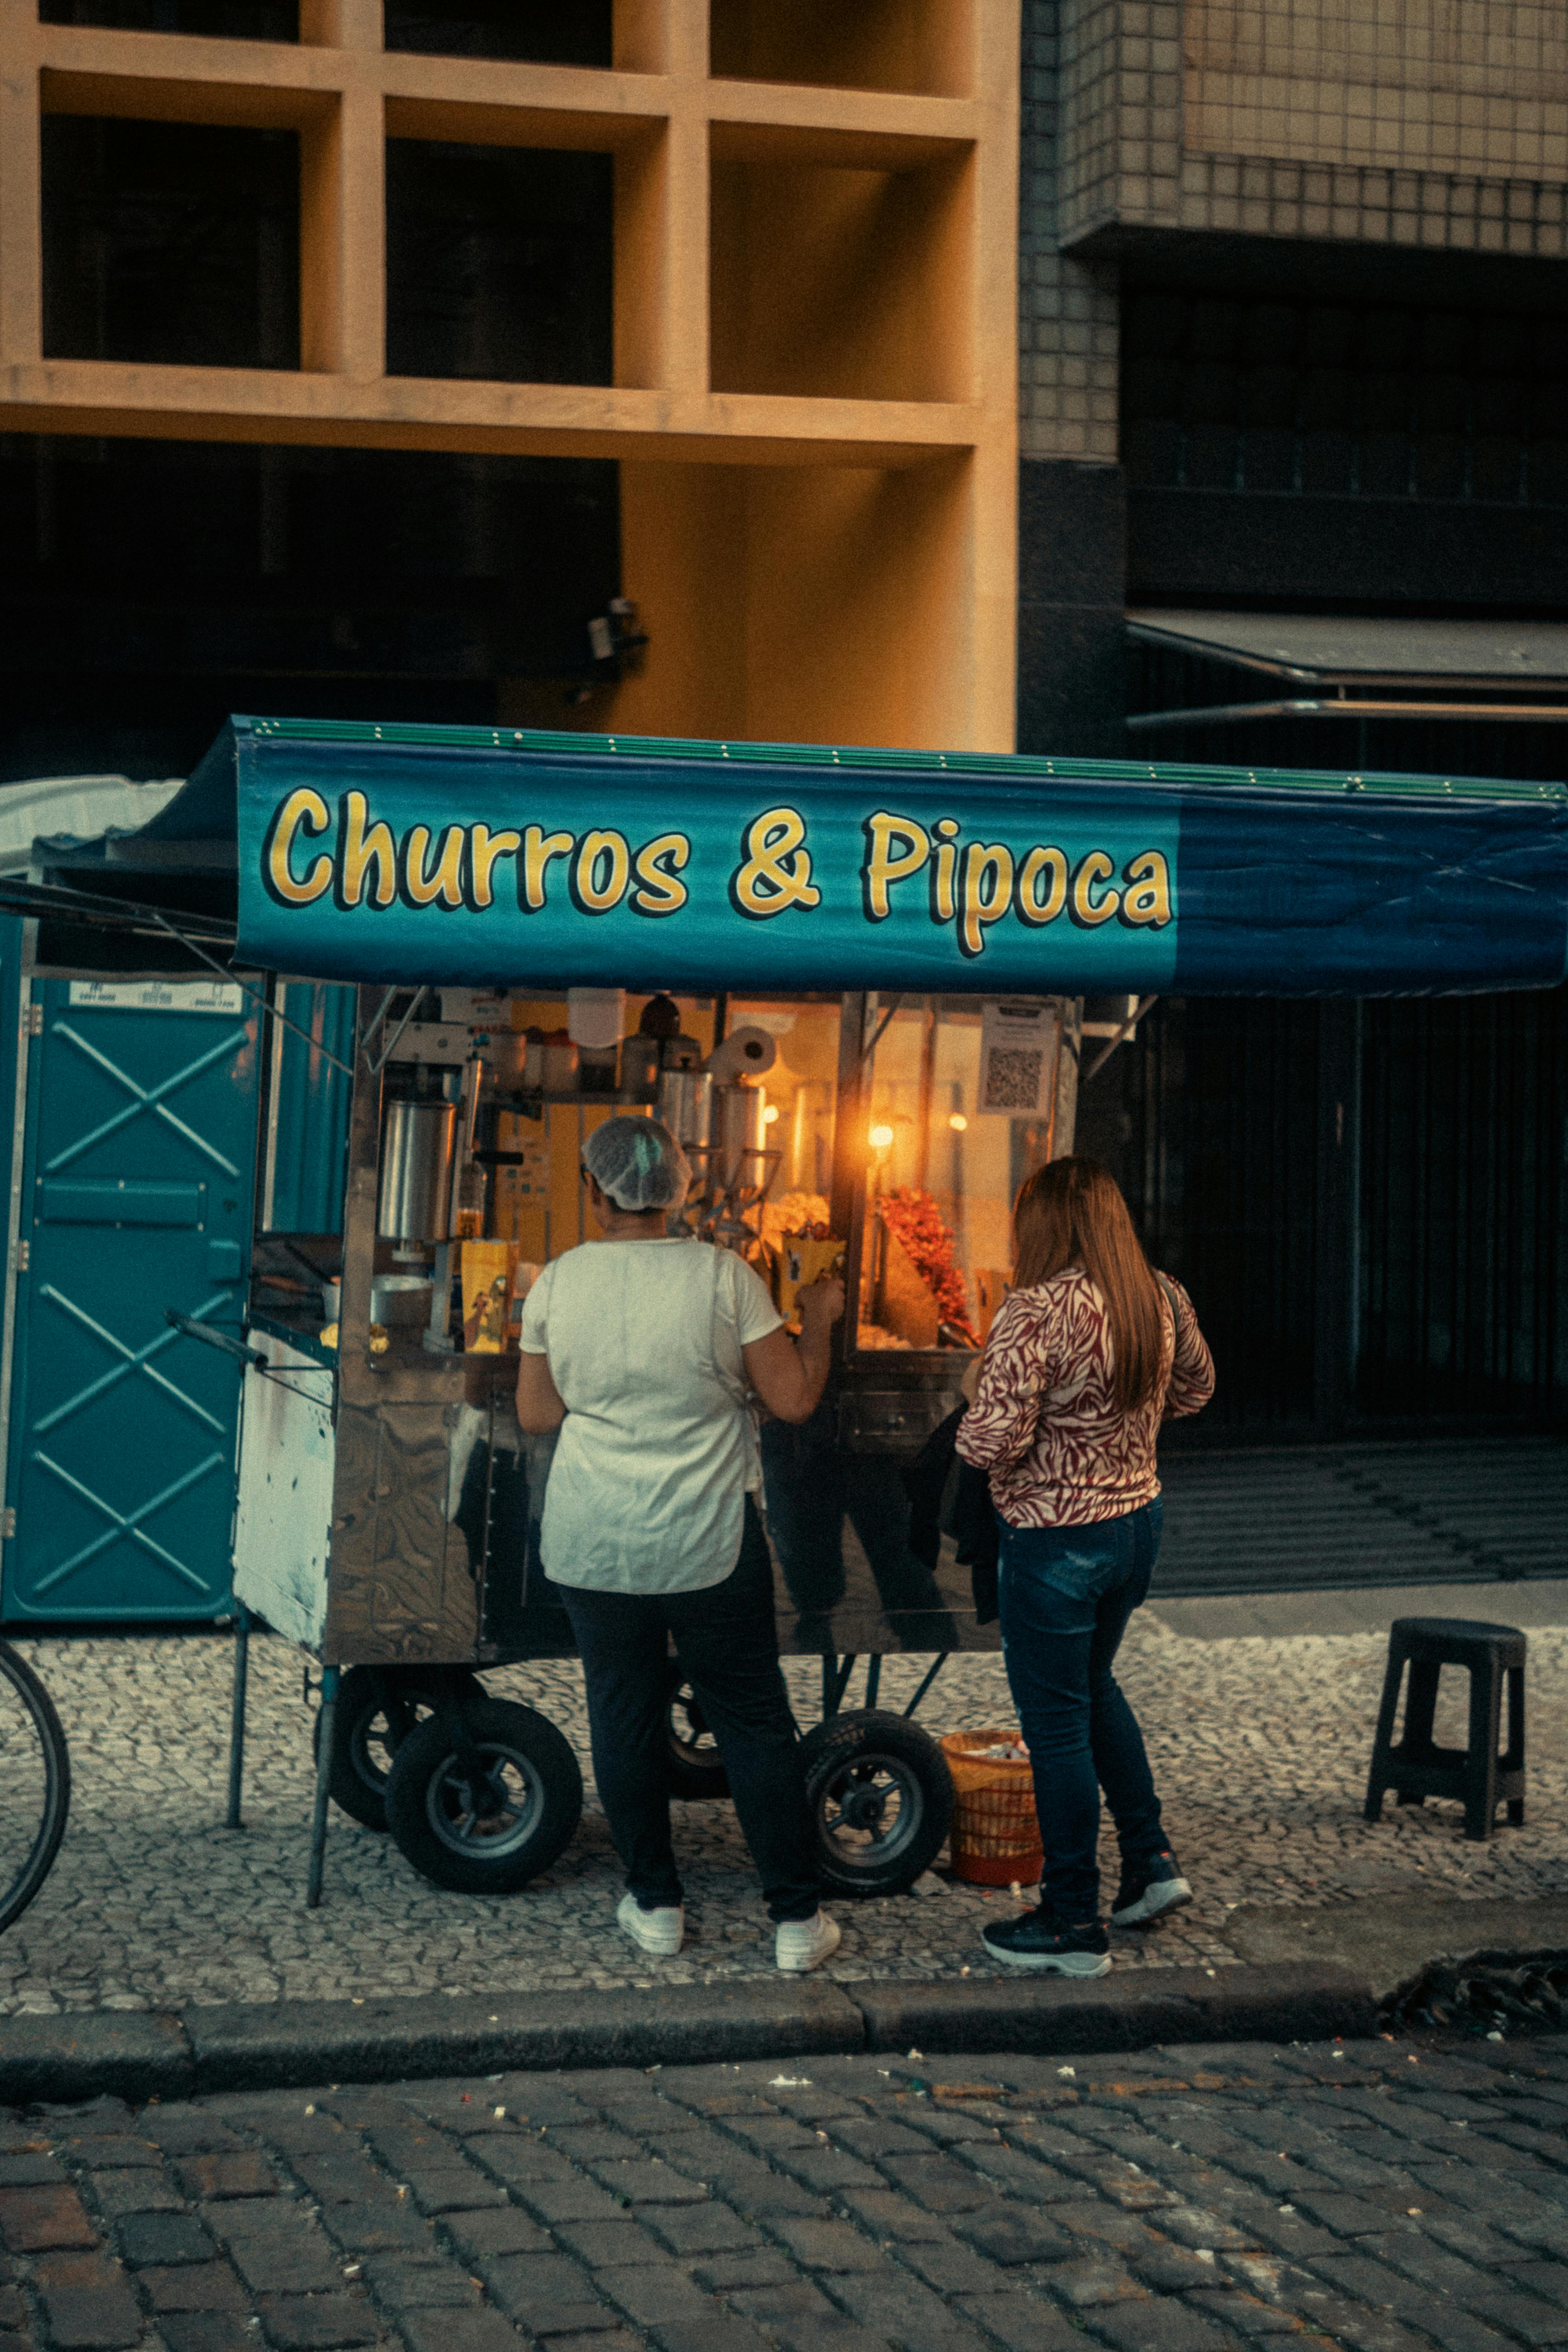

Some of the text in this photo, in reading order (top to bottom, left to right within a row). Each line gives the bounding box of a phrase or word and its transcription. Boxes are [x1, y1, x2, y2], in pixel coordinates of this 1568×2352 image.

[262, 786, 1172, 958] Churros & Pipoca
